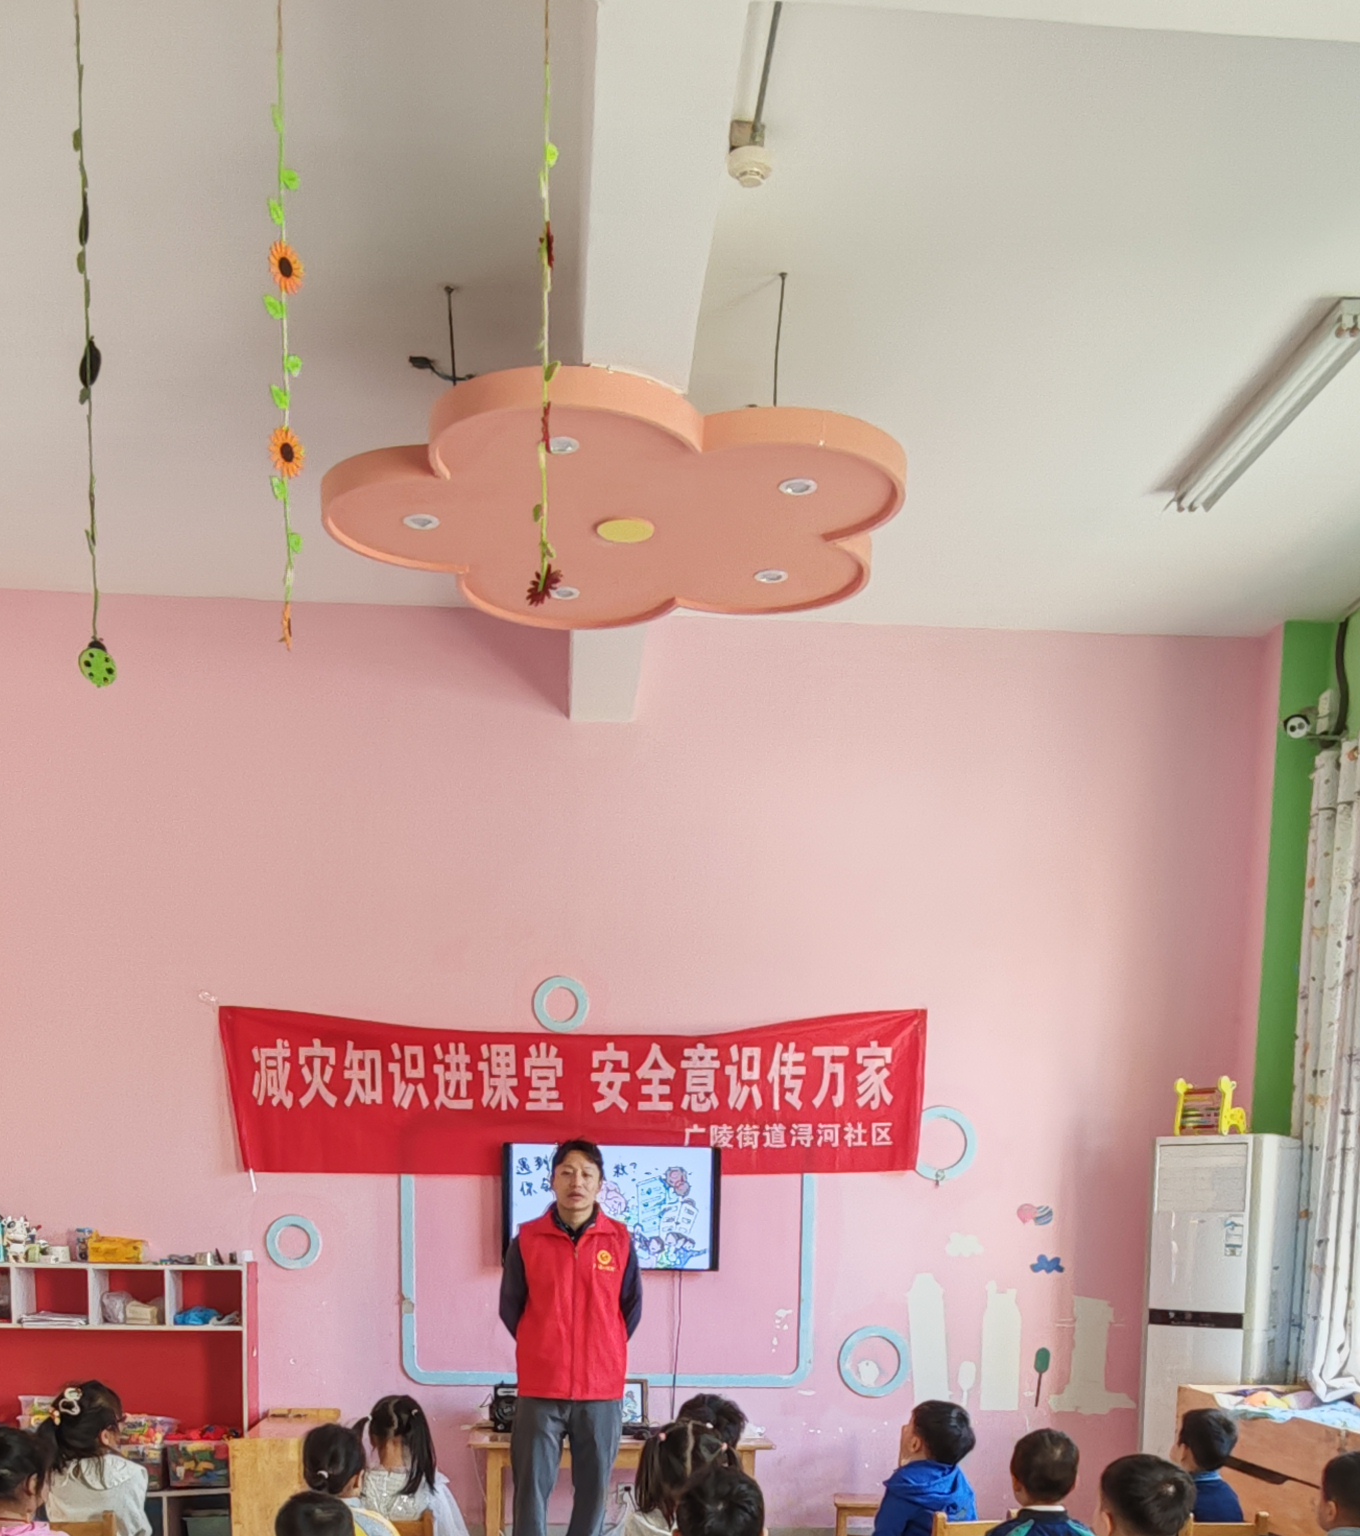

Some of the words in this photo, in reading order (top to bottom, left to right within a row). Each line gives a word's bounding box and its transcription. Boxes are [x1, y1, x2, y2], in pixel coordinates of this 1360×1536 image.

[251, 1038, 564, 1111] 减灾知识进课堂
[590, 1041, 894, 1113] 安全意识传万家
[683, 1121, 894, 1149] 广陵街道浔河社区
